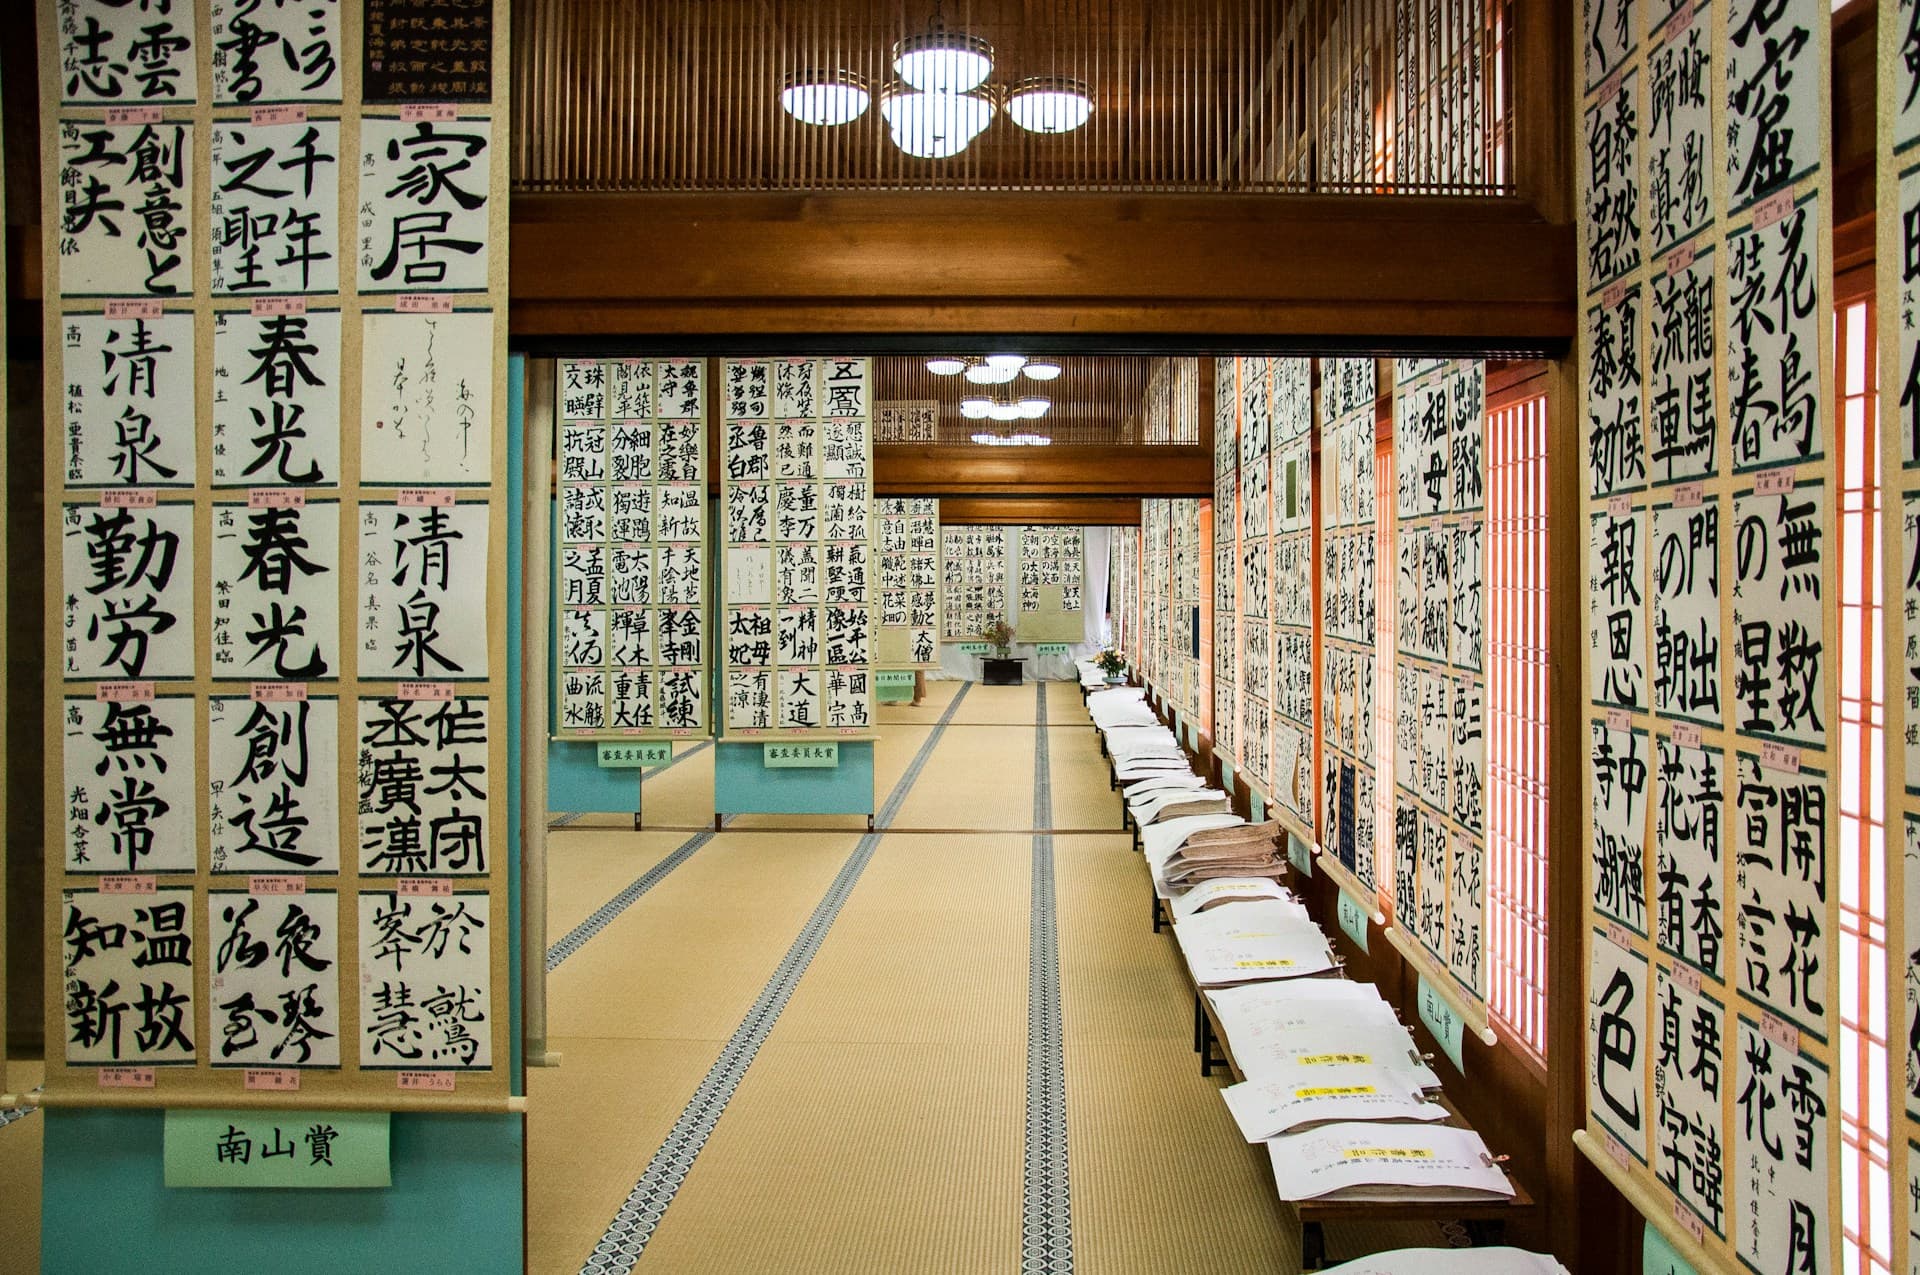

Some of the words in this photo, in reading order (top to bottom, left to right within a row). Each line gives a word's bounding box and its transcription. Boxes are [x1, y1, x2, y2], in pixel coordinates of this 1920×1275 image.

[66, 0, 133, 97] 志
[127, 0, 191, 97] 雲
[68, 129, 127, 237] 工夫
[125, 124, 186, 293] 創意と
[219, 131, 294, 291] 之聖
[275, 127, 335, 289] 千年
[371, 122, 488, 284] 家居
[1589, 110, 1613, 281] 自若
[102, 319, 177, 483] 清泉
[240, 314, 326, 483] 春光
[662, 364, 678, 397] 太守
[1771, 207, 1816, 456] 花鳥
[612, 426, 632, 480] 分裂
[629, 427, 651, 479] 細胞
[660, 490, 680, 538] 知新
[680, 490, 700, 537] 温故
[1422, 389, 1448, 513] 祖母
[84, 507, 179, 677] 勤労
[237, 507, 330, 678] 春光
[392, 506, 465, 672] 清泉
[628, 611, 650, 666] 草木
[631, 550, 650, 604] 太陽
[679, 610, 701, 663] 金剛
[780, 616, 797, 660] 一到
[798, 608, 818, 663] 精神
[1600, 516, 1642, 706] 報恩
[1654, 533, 1689, 713] の朝
[1688, 505, 1719, 714] 門出
[1737, 515, 1776, 732] の星
[1777, 494, 1824, 731] 無数
[565, 676, 584, 725] 曲水
[613, 673, 634, 727] 重大
[632, 671, 653, 726] 責任
[665, 671, 699, 727] 試練
[788, 672, 818, 727] 大道
[93, 701, 174, 871] 無常
[228, 701, 323, 866] 創造
[1656, 745, 1691, 955] 花有
[1688, 752, 1724, 976] 清香
[1737, 760, 1778, 997] 宣言
[1779, 784, 1825, 1017] 開花
[64, 906, 130, 1058] 知新
[131, 901, 194, 1052] 温故
[1598, 966, 1640, 1131] 色
[216, 1125, 339, 1167] 南山賞
[1737, 1032, 1783, 1161] 花
